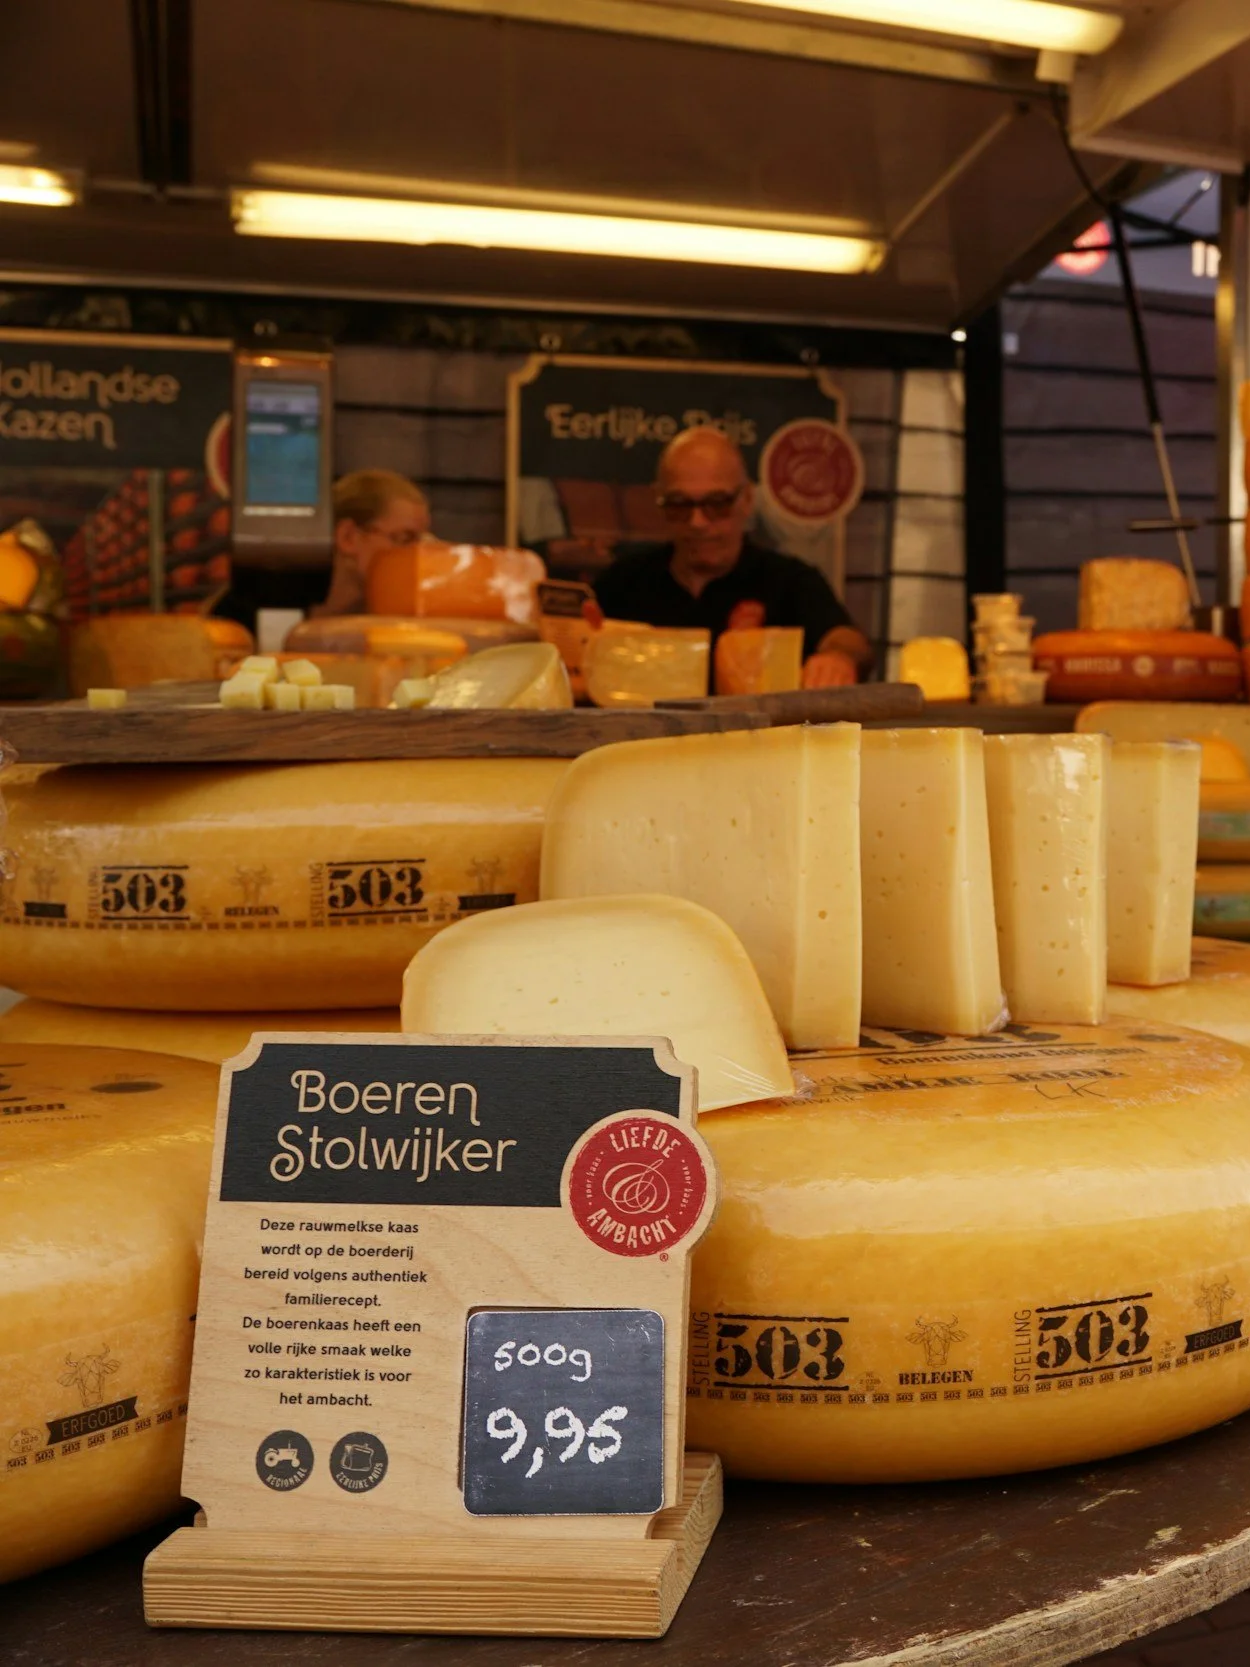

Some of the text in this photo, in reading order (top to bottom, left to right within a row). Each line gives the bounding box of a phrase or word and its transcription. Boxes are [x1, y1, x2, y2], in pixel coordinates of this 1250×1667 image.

[0, 361, 181, 408] ollandse
[545, 403, 678, 448] Eerlijke
[102, 873, 186, 913] 503
[328, 867, 424, 909] 503
[290, 1070, 481, 1126] Boeren
[270, 1125, 517, 1182] Stolwijker
[609, 1126, 682, 1159] LIEFDE
[261, 1219, 418, 1233] Deze rauwmelkse kaas
[587, 1208, 677, 1249] AMBACHT
[262, 1244, 413, 1260] wordt op de boerderij
[245, 1268, 427, 1283] bereid volgens authentiek
[285, 1293, 381, 1308] familierecept.
[243, 1317, 420, 1332] De boerenkaas heeft een
[1194, 1325, 1236, 1350] ERFGOED
[249, 1342, 411, 1357] volle rijke smaak welke
[494, 1341, 592, 1382] 500g
[690, 1311, 845, 1387] STELLING 503
[1013, 1305, 1149, 1383] STELLING 503
[244, 1367, 412, 1382] zo karakteristiek is voor
[707, 1389, 723, 1400] 503
[730, 1390, 746, 1401] 503
[754, 1391, 770, 1403] 503
[777, 1392, 793, 1403] 503
[801, 1393, 817, 1404] 503
[824, 1393, 841, 1404] 503
[848, 1394, 866, 1404] 503
[873, 1393, 889, 1403] 503
[896, 1392, 914, 1402] 503
[920, 1391, 937, 1401] 503
[944, 1390, 960, 1401] 503
[967, 1388, 984, 1399] 503
[991, 1387, 1007, 1398] 503
[1014, 1385, 1029, 1395] 503
[1036, 1383, 1052, 1393] 503
[1057, 1380, 1073, 1391] 503
[1079, 1377, 1094, 1387] 503
[1100, 1373, 1114, 1383] 503
[1120, 1369, 1134, 1380] 503
[1140, 1364, 1152, 1374] 503
[1158, 1361, 1170, 1371] 503
[1176, 1357, 1187, 1367] 503
[898, 1369, 974, 1386] BELEGEN
[280, 1393, 372, 1406] het ambacht.
[7, 1403, 188, 1468] 503 503 503 503 503 503 503 50
[61, 1405, 126, 1438] ERFGOED
[487, 1406, 628, 1478] 9,95
[266, 1467, 308, 1487] REGIONAAL
